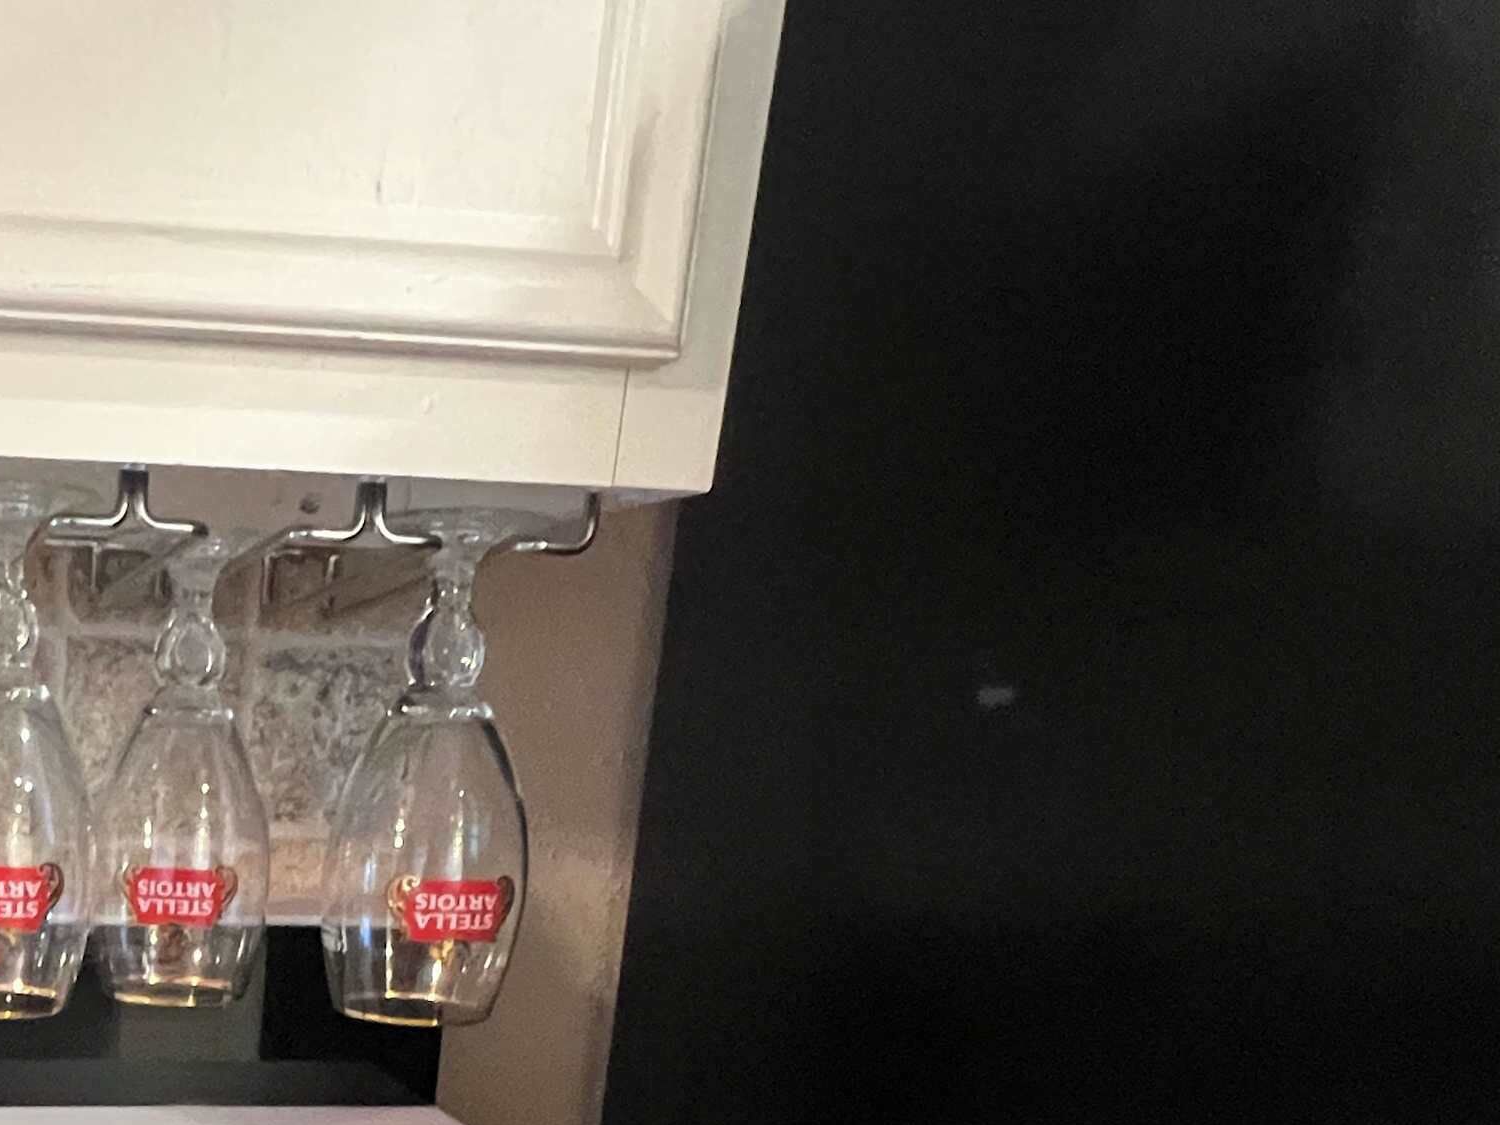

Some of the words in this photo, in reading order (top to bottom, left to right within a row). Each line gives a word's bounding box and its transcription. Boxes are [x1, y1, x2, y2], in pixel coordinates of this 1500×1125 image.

[137, 878, 216, 897] ARTOIS
[137, 896, 214, 916] STELLA
[415, 892, 498, 911] ARTOIS
[414, 911, 494, 930] STELLA
